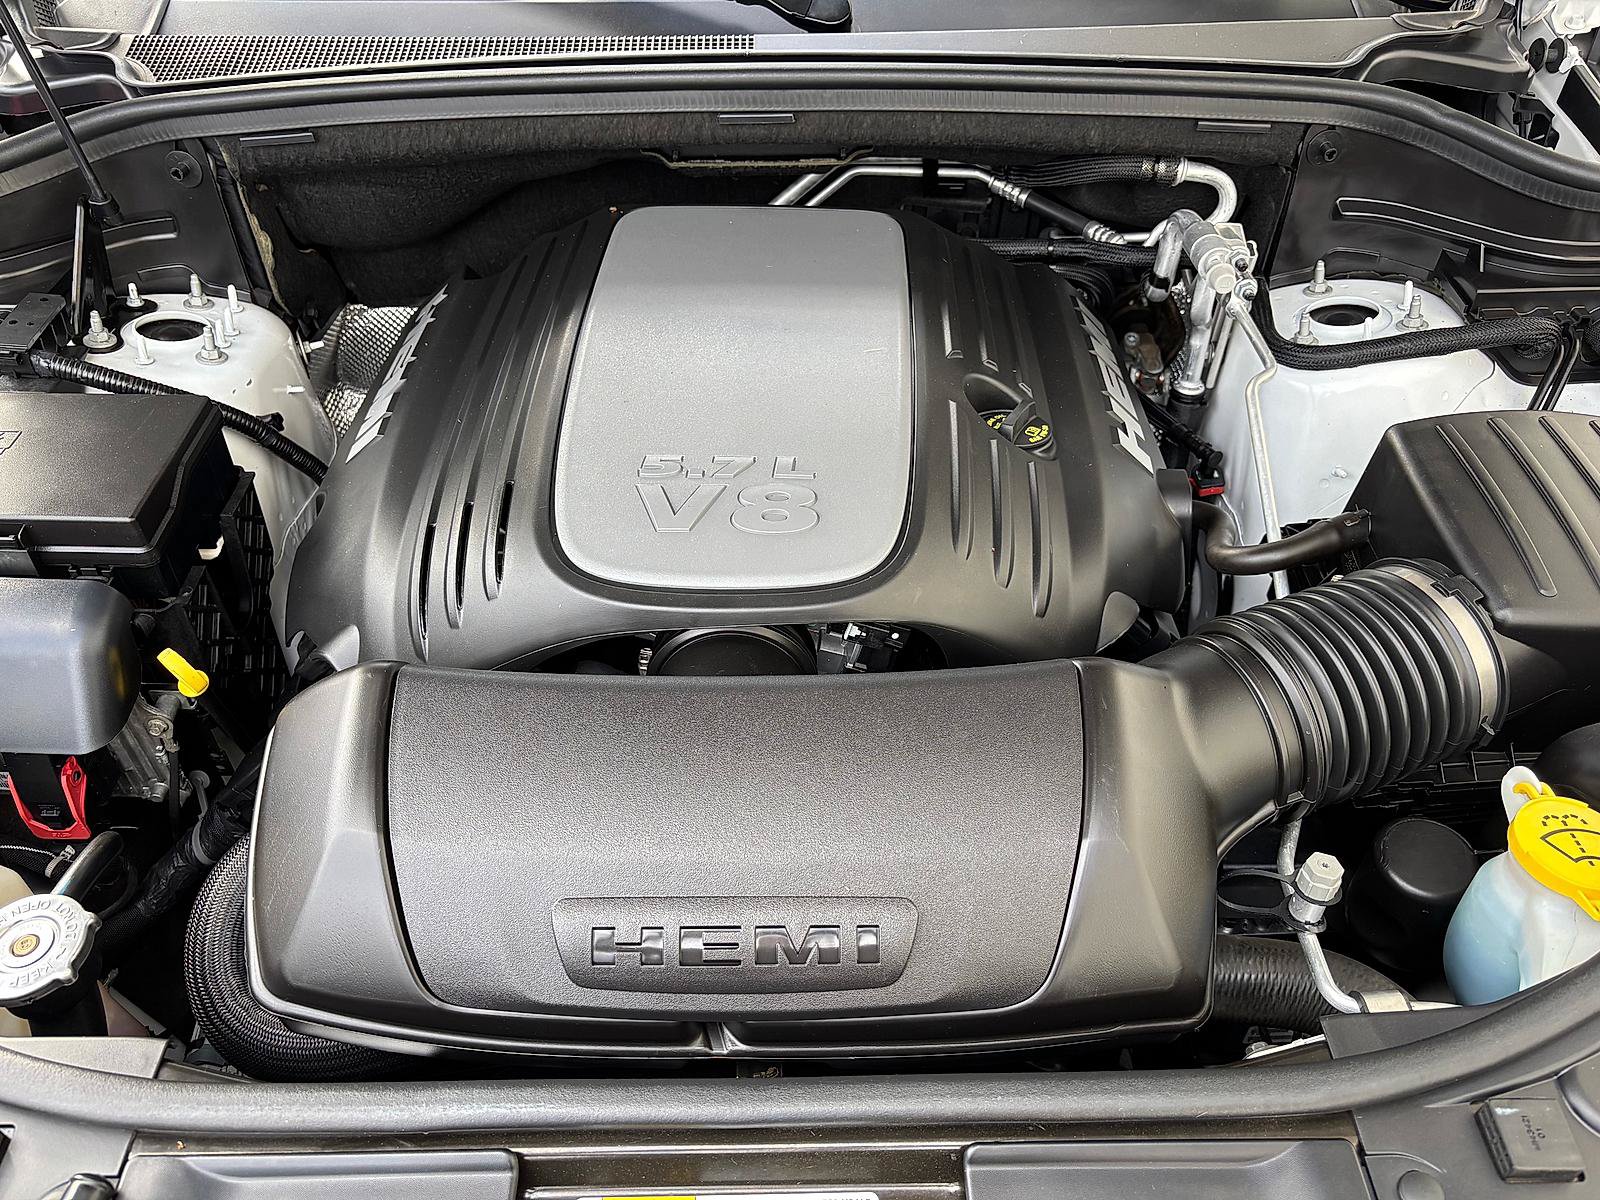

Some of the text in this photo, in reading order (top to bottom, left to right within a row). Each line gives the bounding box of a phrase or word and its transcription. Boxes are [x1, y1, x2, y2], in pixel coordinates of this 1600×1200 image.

[1074, 296, 1155, 476] HEMI
[636, 454, 818, 480] 5.7 L
[634, 482, 821, 535] V8
[11, 899, 51, 918] OPEN
[590, 925, 881, 967] HEMI
